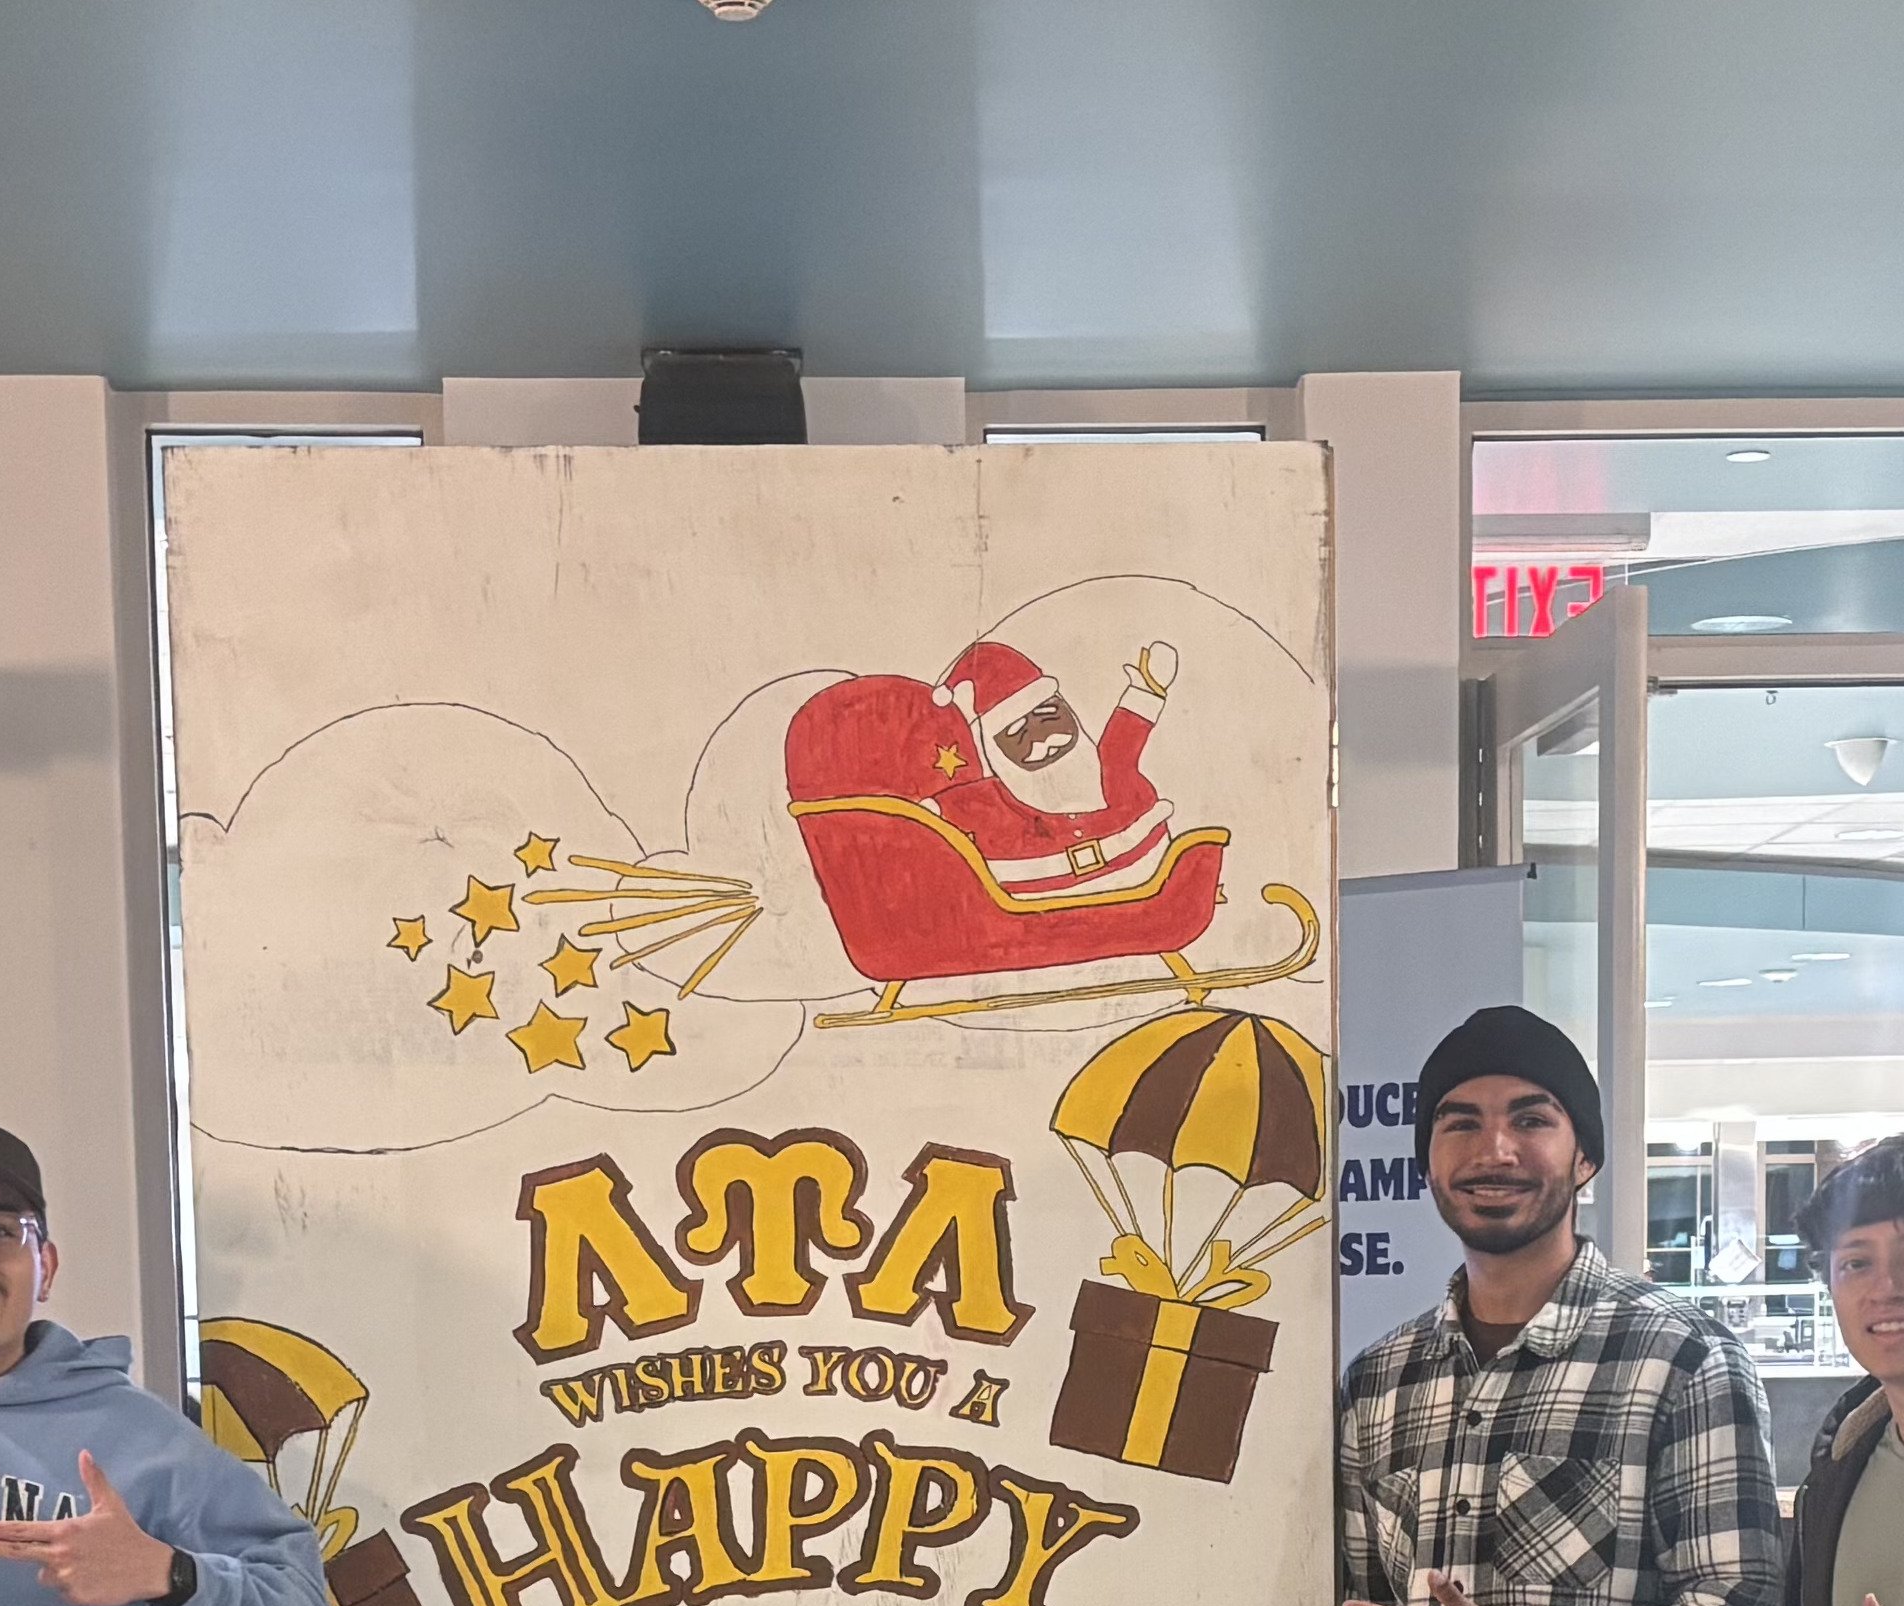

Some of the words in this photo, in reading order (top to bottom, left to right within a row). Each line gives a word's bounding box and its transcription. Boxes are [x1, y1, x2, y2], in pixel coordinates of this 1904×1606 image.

[1338, 1082, 1419, 1129] UCE
[1339, 1231, 1404, 1276] SE.
[541, 1342, 787, 1428] WISHES
[798, 1345, 948, 1414] YOU
[952, 1370, 1010, 1428] A
